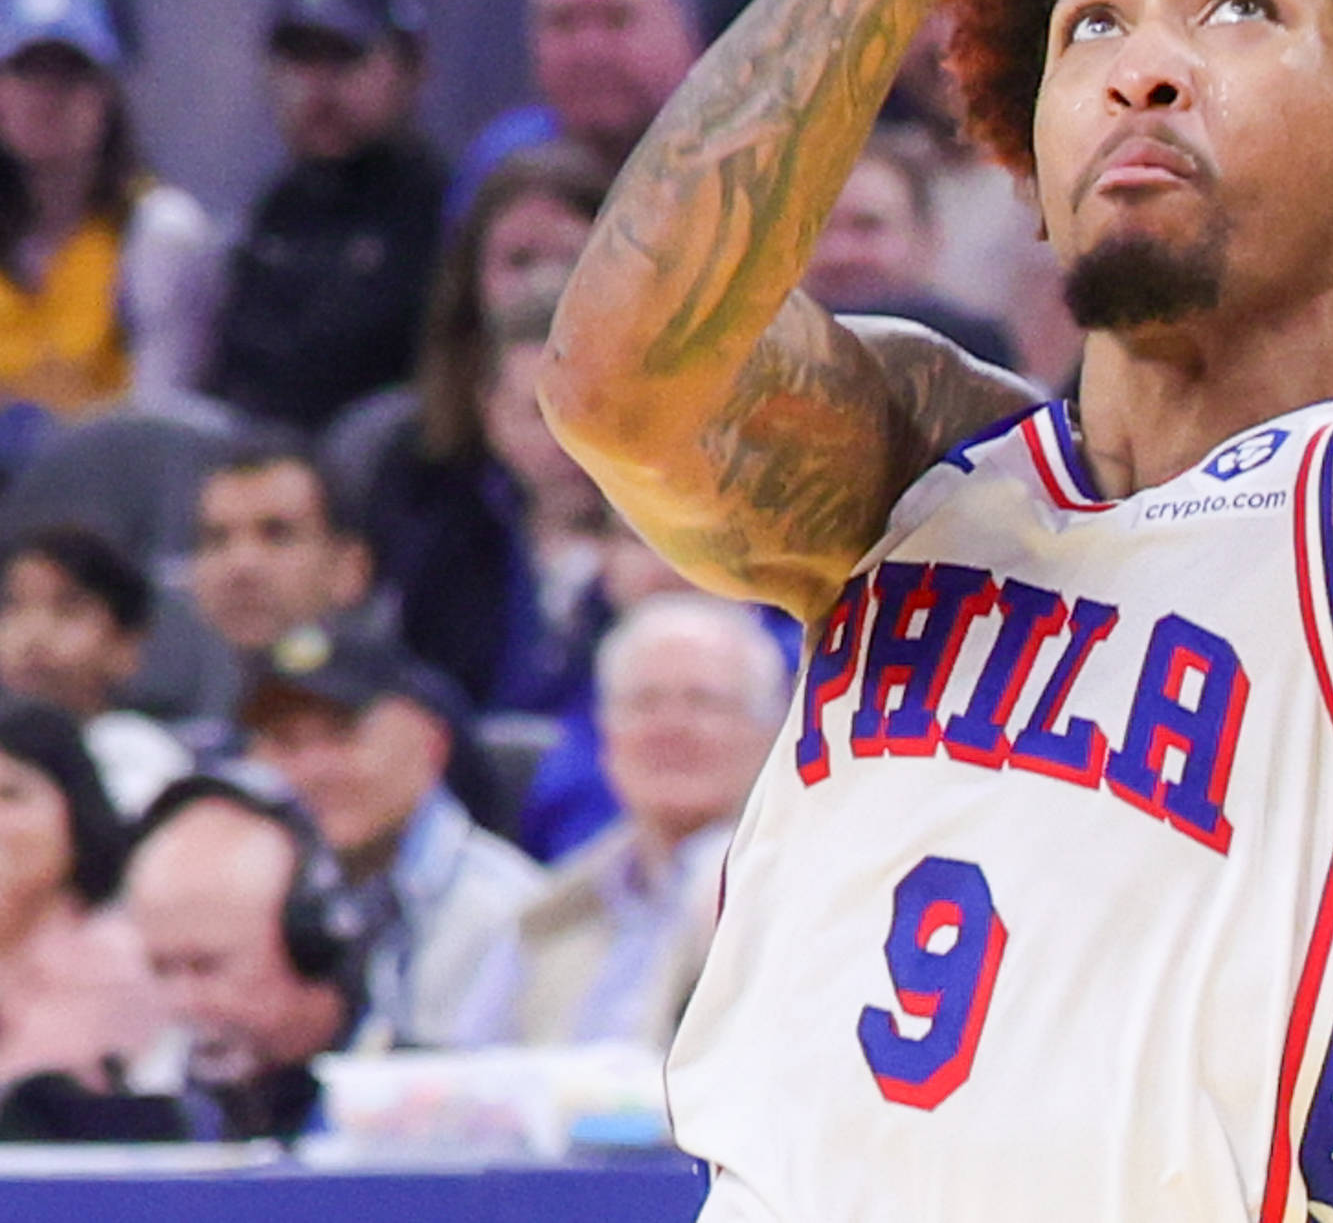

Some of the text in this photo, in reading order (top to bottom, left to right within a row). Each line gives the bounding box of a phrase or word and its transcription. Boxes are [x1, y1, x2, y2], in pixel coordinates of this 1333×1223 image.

[1145, 489, 1287, 521] crypto.com
[795, 561, 1251, 857] PHILA
[857, 855, 1009, 1112] 9
